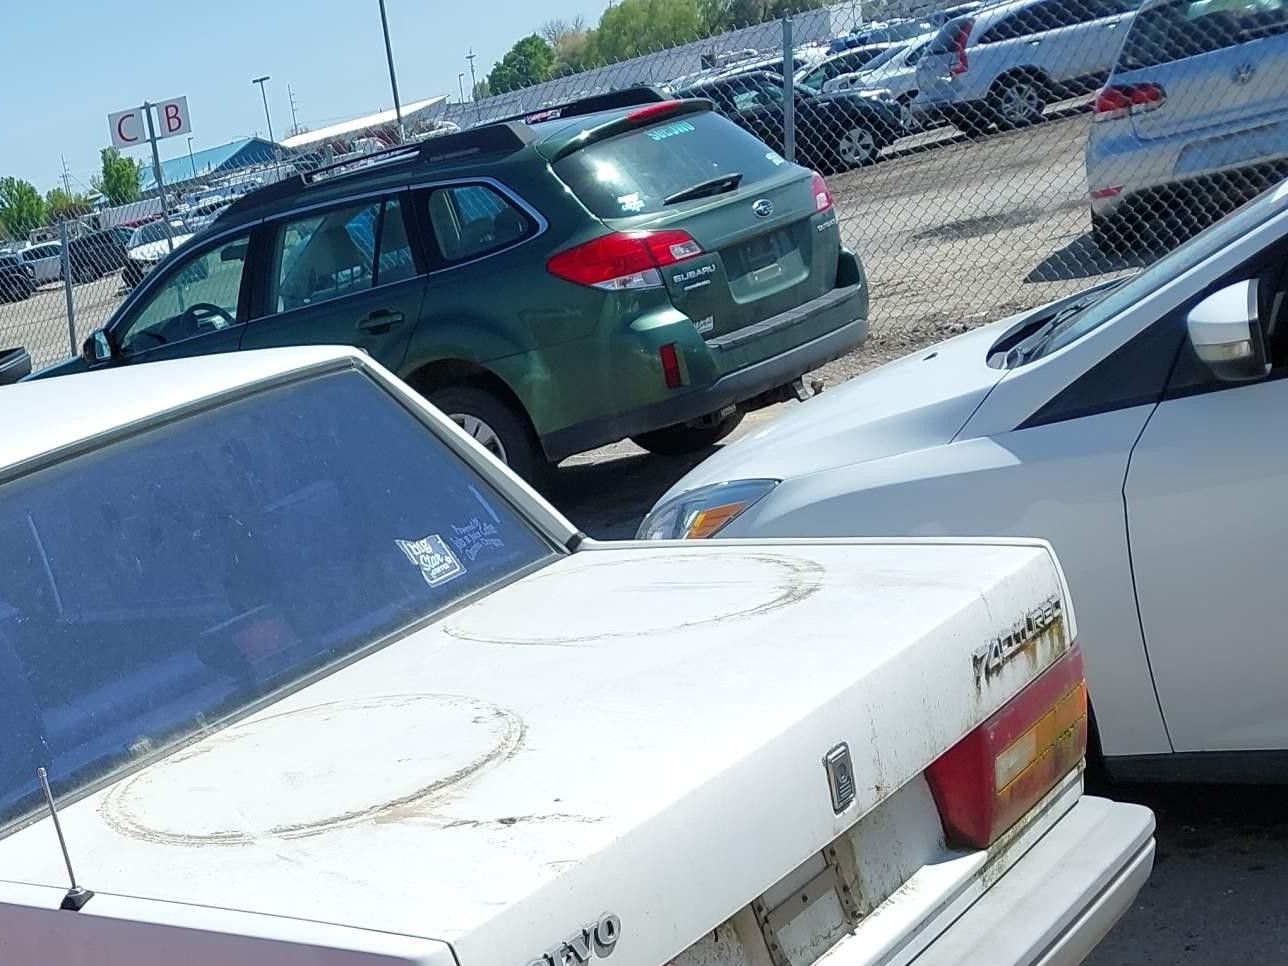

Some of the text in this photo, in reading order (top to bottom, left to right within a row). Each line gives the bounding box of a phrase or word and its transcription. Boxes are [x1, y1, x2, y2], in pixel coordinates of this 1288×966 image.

[117, 113, 138, 142] C
[164, 104, 182, 133] B
[672, 263, 716, 283] SUBARU
[419, 551, 445, 572] Star
